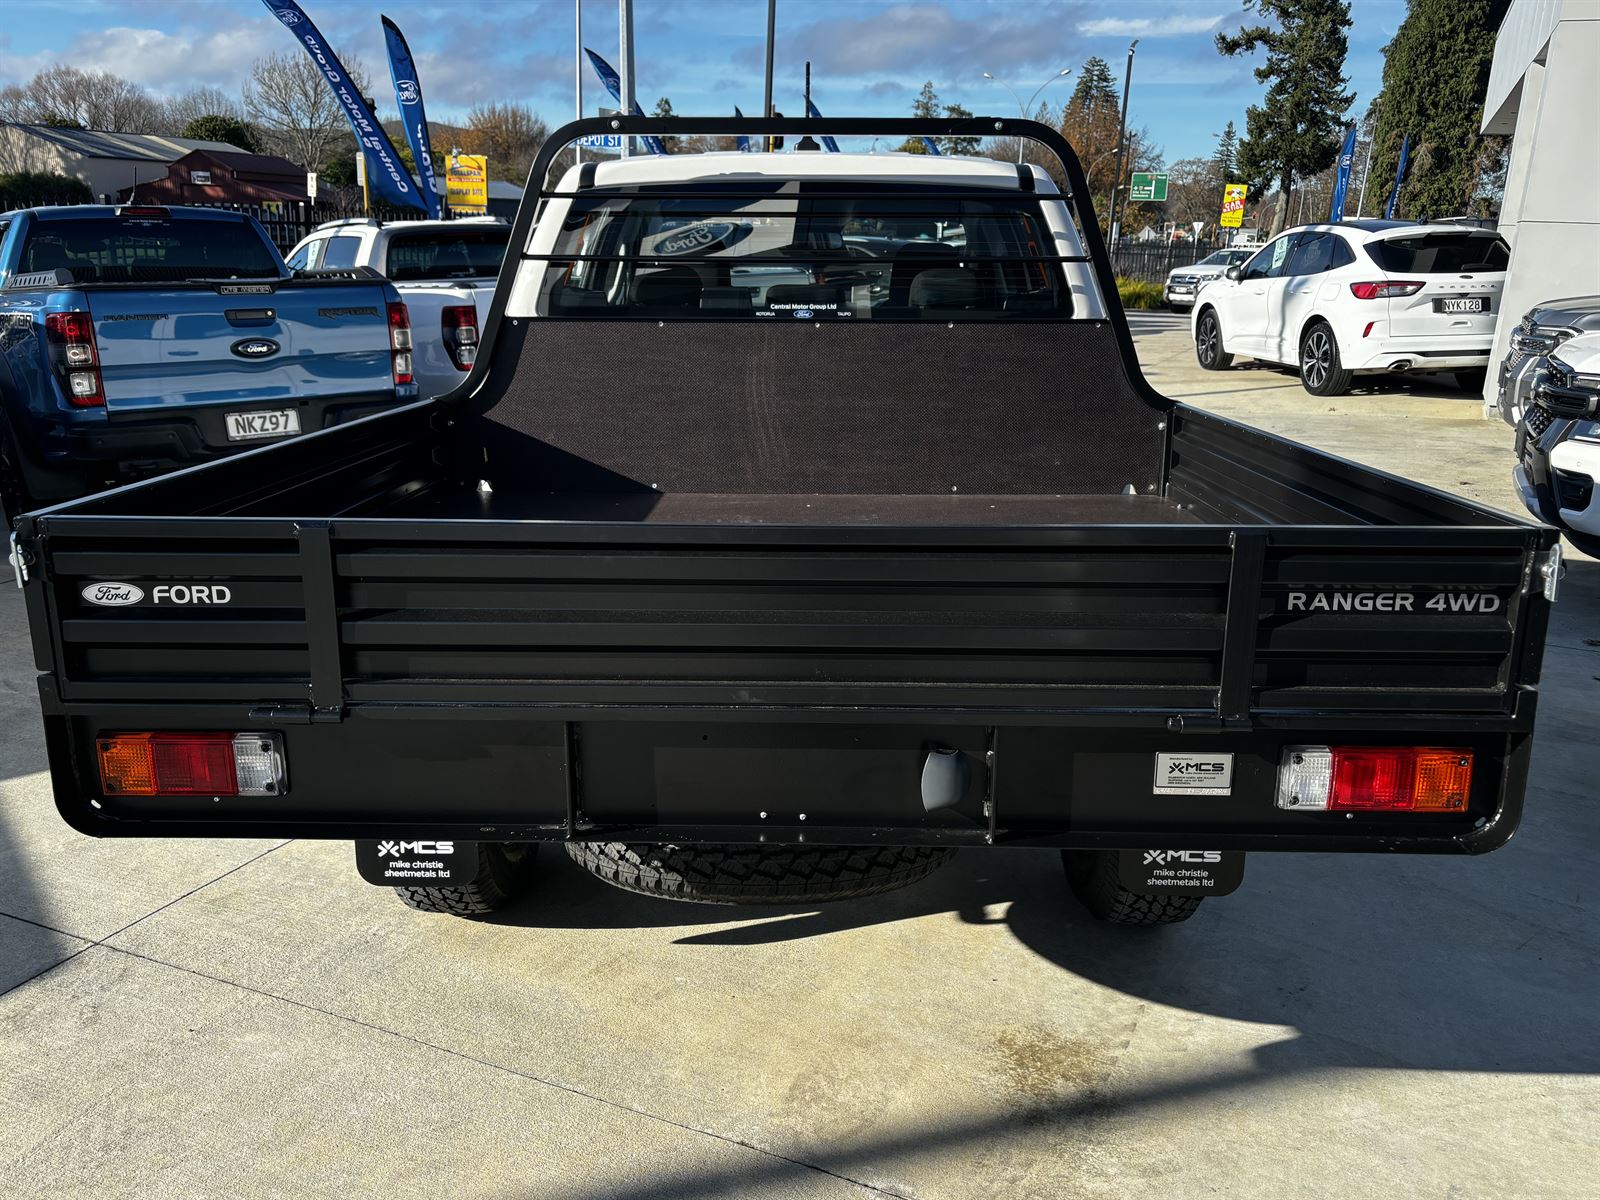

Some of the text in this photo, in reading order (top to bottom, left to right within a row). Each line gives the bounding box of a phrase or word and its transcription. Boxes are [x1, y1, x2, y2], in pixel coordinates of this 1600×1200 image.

[608, 135, 619, 146] ST
[1444, 300, 1481, 311] NYK128
[234, 413, 289, 434] NKZ97
[152, 585, 231, 604] FORD
[1287, 592, 1500, 613] RANGER 4WD
[1185, 763, 1225, 771] MCS
[400, 841, 454, 854] MCS
[1167, 850, 1222, 863] MCS
[389, 860, 444, 869] mike christie
[384, 869, 451, 878] sheetmetals ltd
[1153, 868, 1209, 878] mike christie
[1146, 877, 1214, 887] sheetmetals ltd
